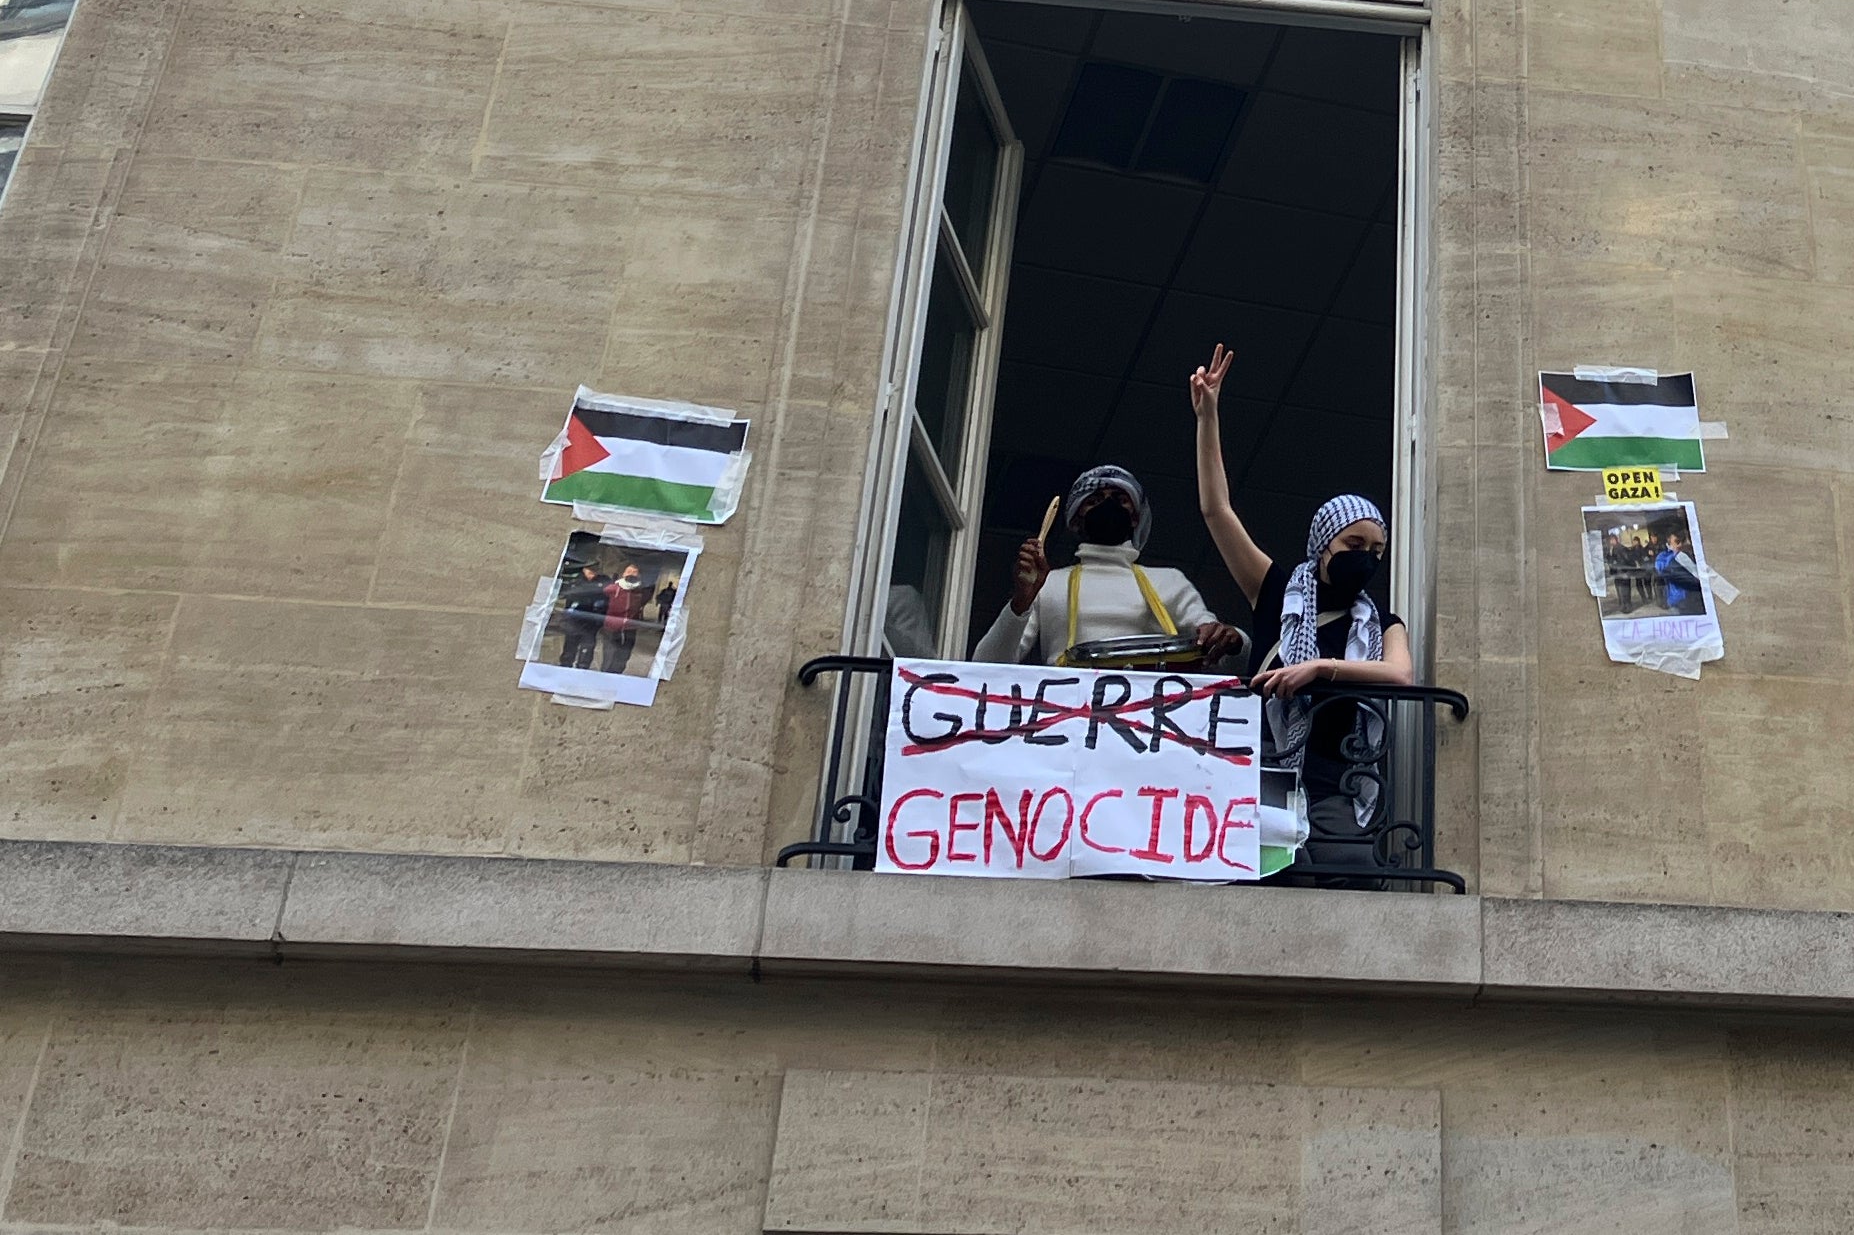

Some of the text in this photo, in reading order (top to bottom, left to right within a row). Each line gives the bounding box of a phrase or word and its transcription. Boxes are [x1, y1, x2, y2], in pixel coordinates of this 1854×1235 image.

[1606, 471, 1655, 485] OPEN
[901, 673, 1255, 757] GUERRE
[885, 785, 1257, 873] GENOCIDE
